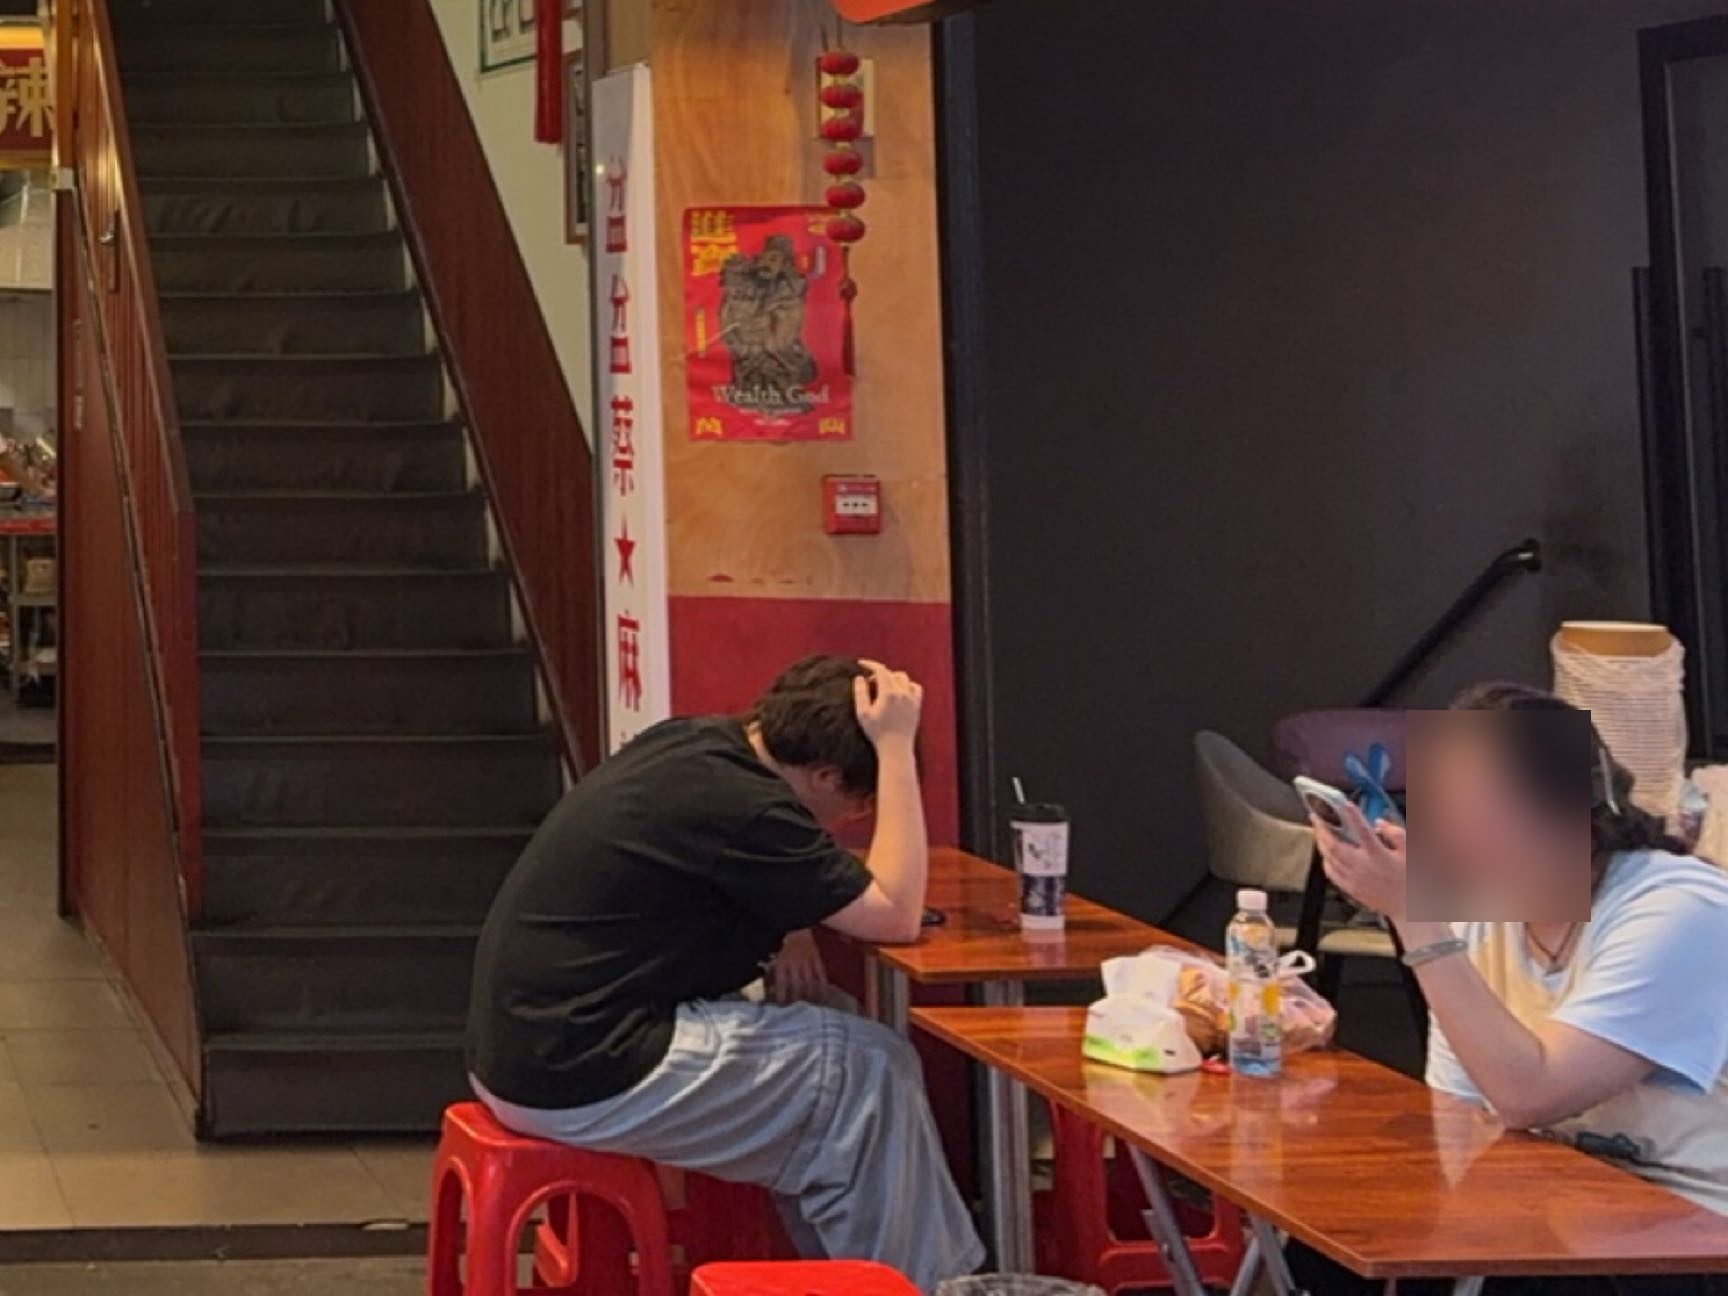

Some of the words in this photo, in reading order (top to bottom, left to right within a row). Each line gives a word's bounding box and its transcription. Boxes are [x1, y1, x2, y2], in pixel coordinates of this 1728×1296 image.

[605, 155, 636, 497] 盆盆蔡
[713, 384, 780, 405] Wealth
[786, 385, 829, 405] God
[617, 608, 642, 713] 麻
